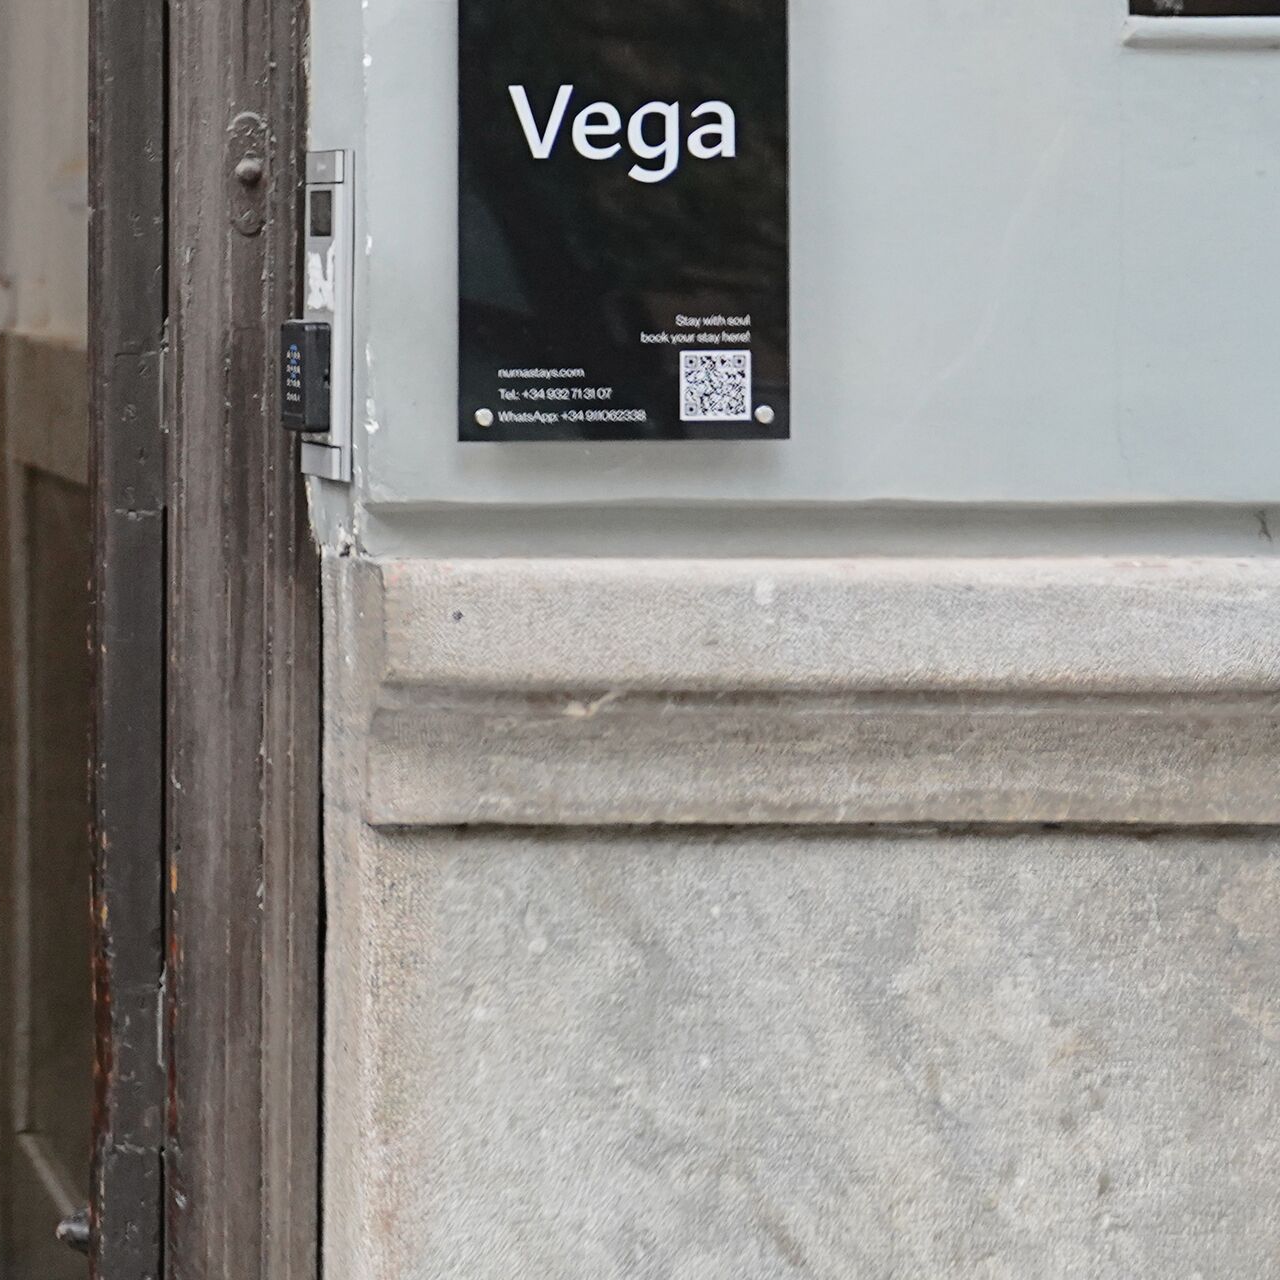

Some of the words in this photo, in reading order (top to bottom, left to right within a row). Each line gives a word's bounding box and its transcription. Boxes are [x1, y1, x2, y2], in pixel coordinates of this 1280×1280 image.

[507, 84, 737, 184] Vega
[675, 314, 701, 328] Stay
[702, 314, 726, 326] with
[727, 314, 752, 326] soul
[640, 330, 669, 343] book
[670, 332, 695, 345] your
[696, 332, 721, 345] stay
[721, 330, 752, 343] here!
[497, 367, 586, 380] numastays.com
[497, 387, 521, 401] Tel:
[521, 387, 545, 401] +34
[560, 409, 584, 422] +34
